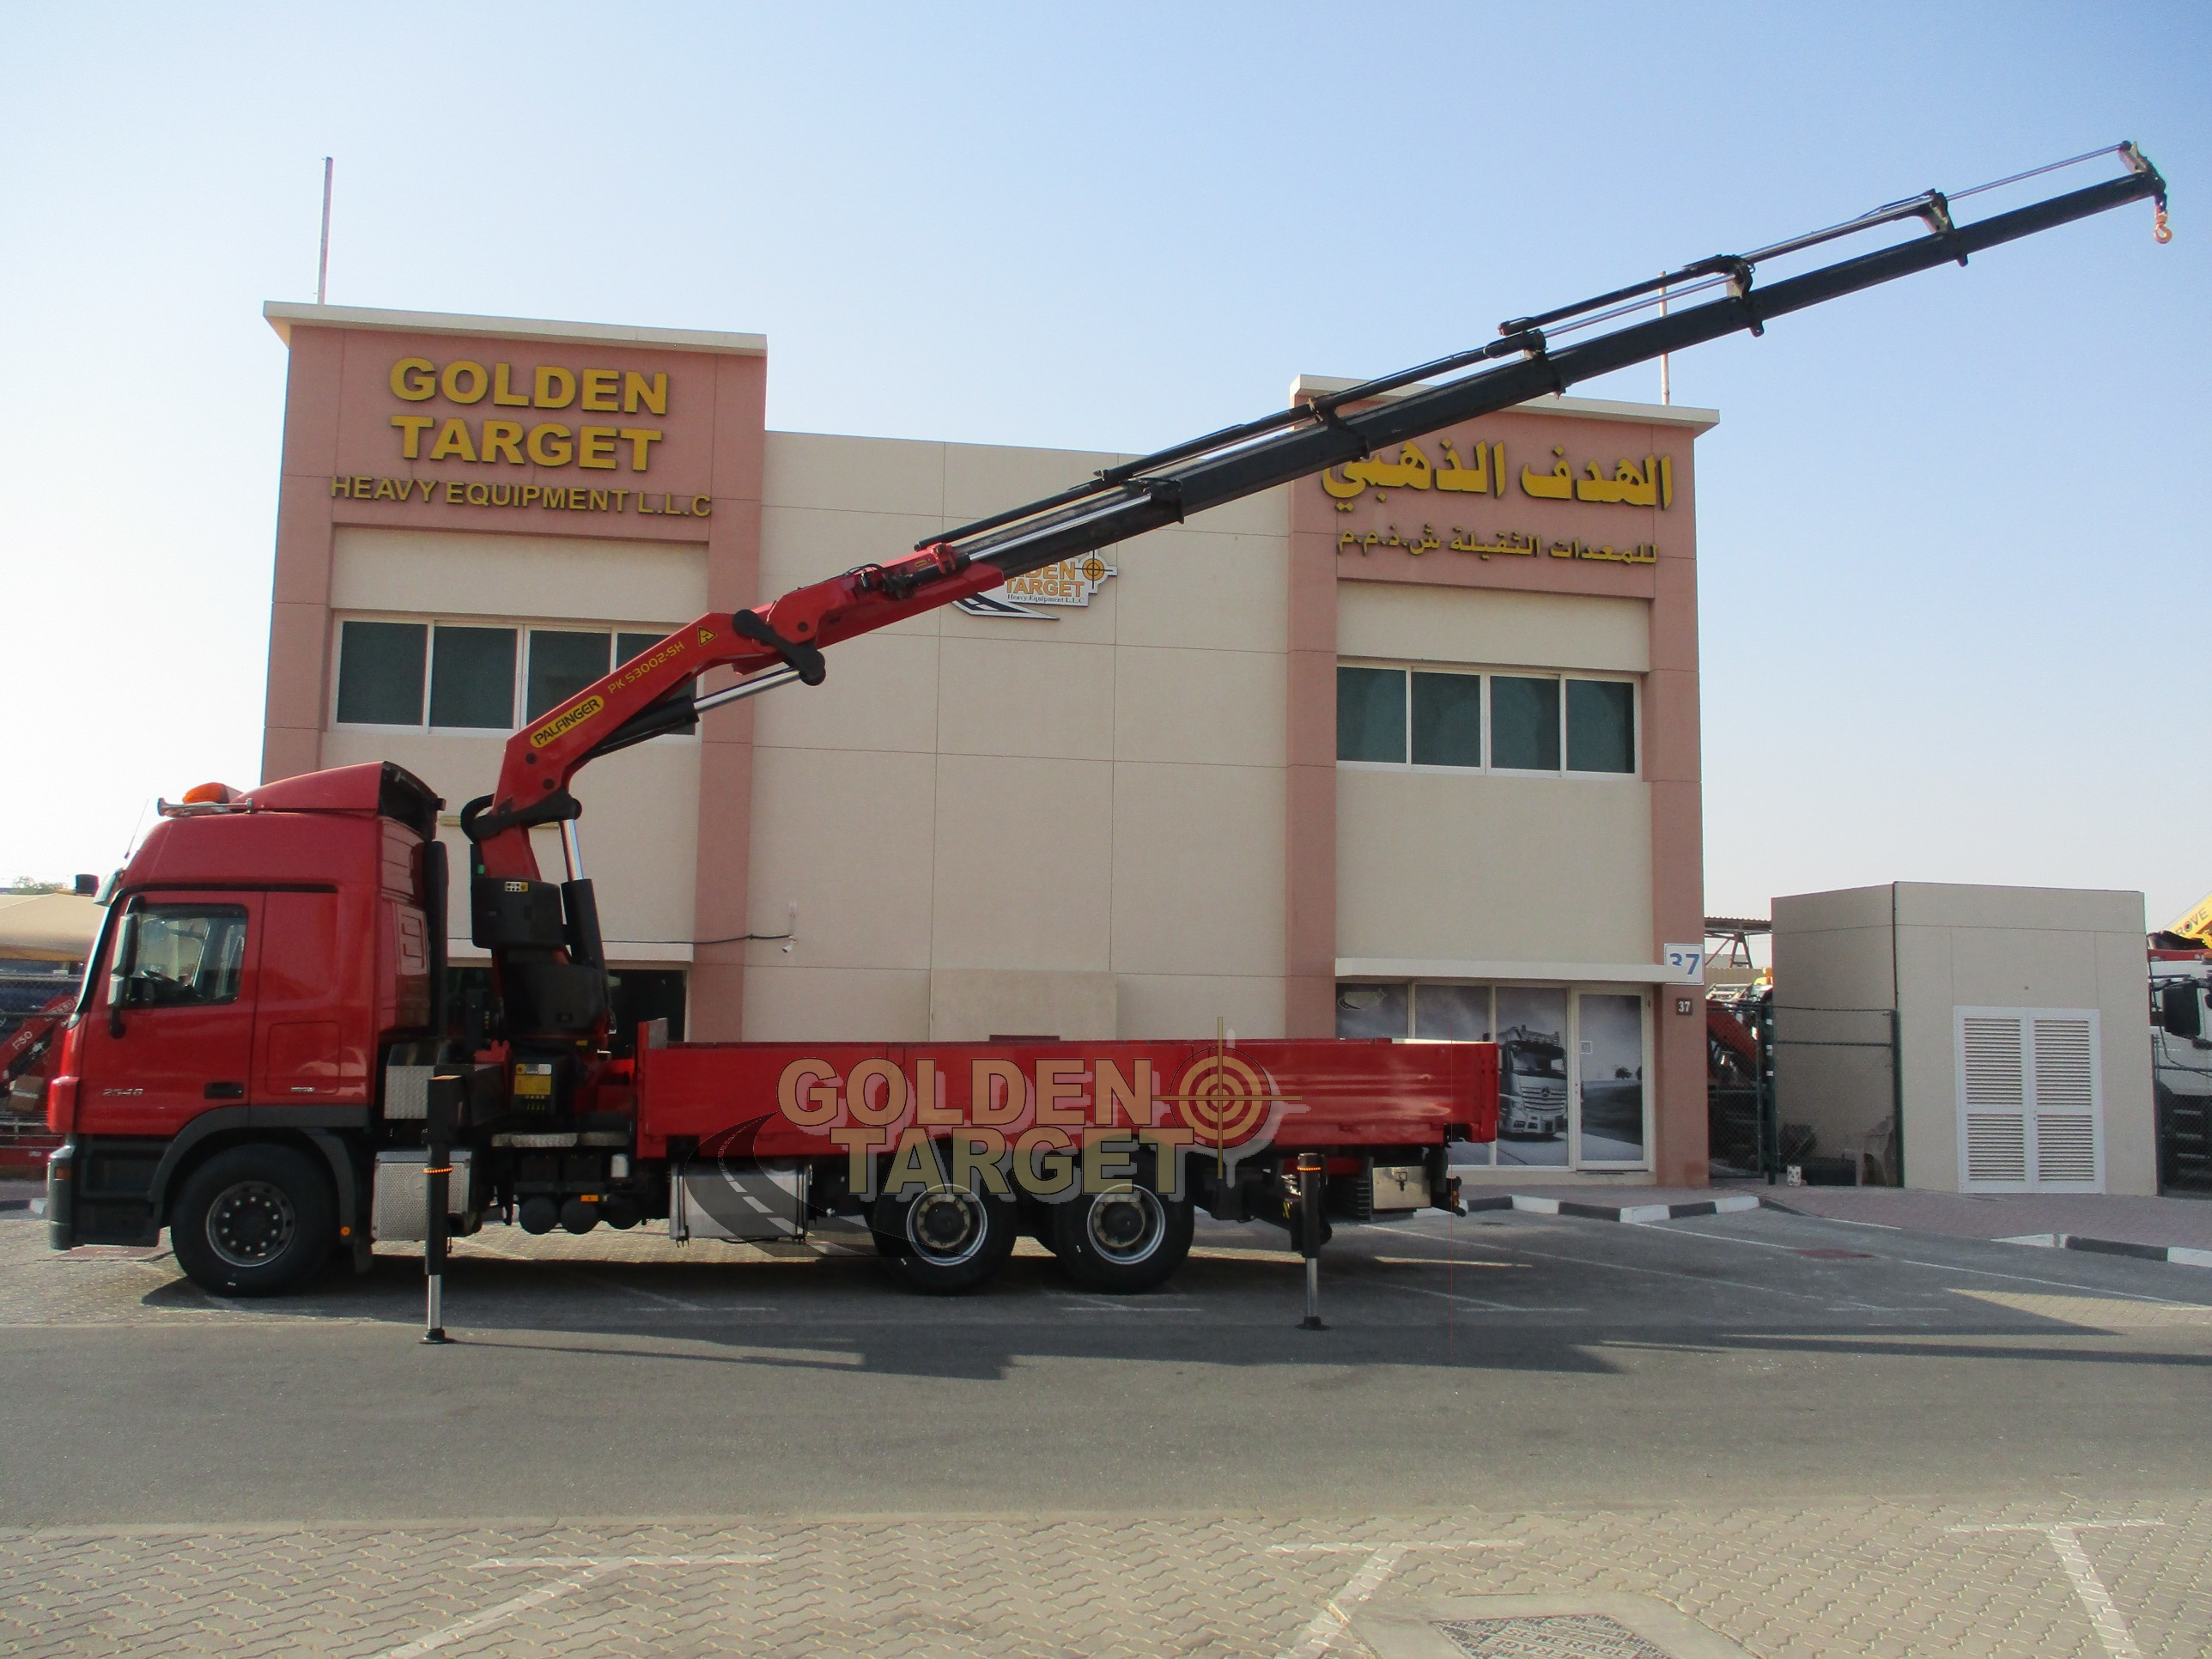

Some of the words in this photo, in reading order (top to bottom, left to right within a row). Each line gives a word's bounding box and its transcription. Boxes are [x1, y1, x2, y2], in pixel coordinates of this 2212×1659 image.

[390, 357, 669, 416] GOLDEN
[391, 415, 663, 471] TARGET
[1322, 438, 1506, 513] الذهبي
[1522, 443, 1673, 510] الهدف
[331, 476, 438, 502] HEAVY
[446, 480, 629, 513] EQUIPMENT
[638, 490, 712, 517] L.L.C
[1449, 526, 1542, 561] الثقيلة
[1548, 537, 1658, 564] للمعدات
[1006, 578, 1085, 597] TARGET
[608, 678, 625, 694] PK
[625, 641, 685, 684] 53002-SH
[533, 698, 601, 745] PALFINGER
[2175, 907, 2209, 935] ROVE
[1669, 952, 1700, 975] 37
[1678, 1001, 1691, 1012] 37
[1505, 1627, 1628, 1656] SEWERAGE
